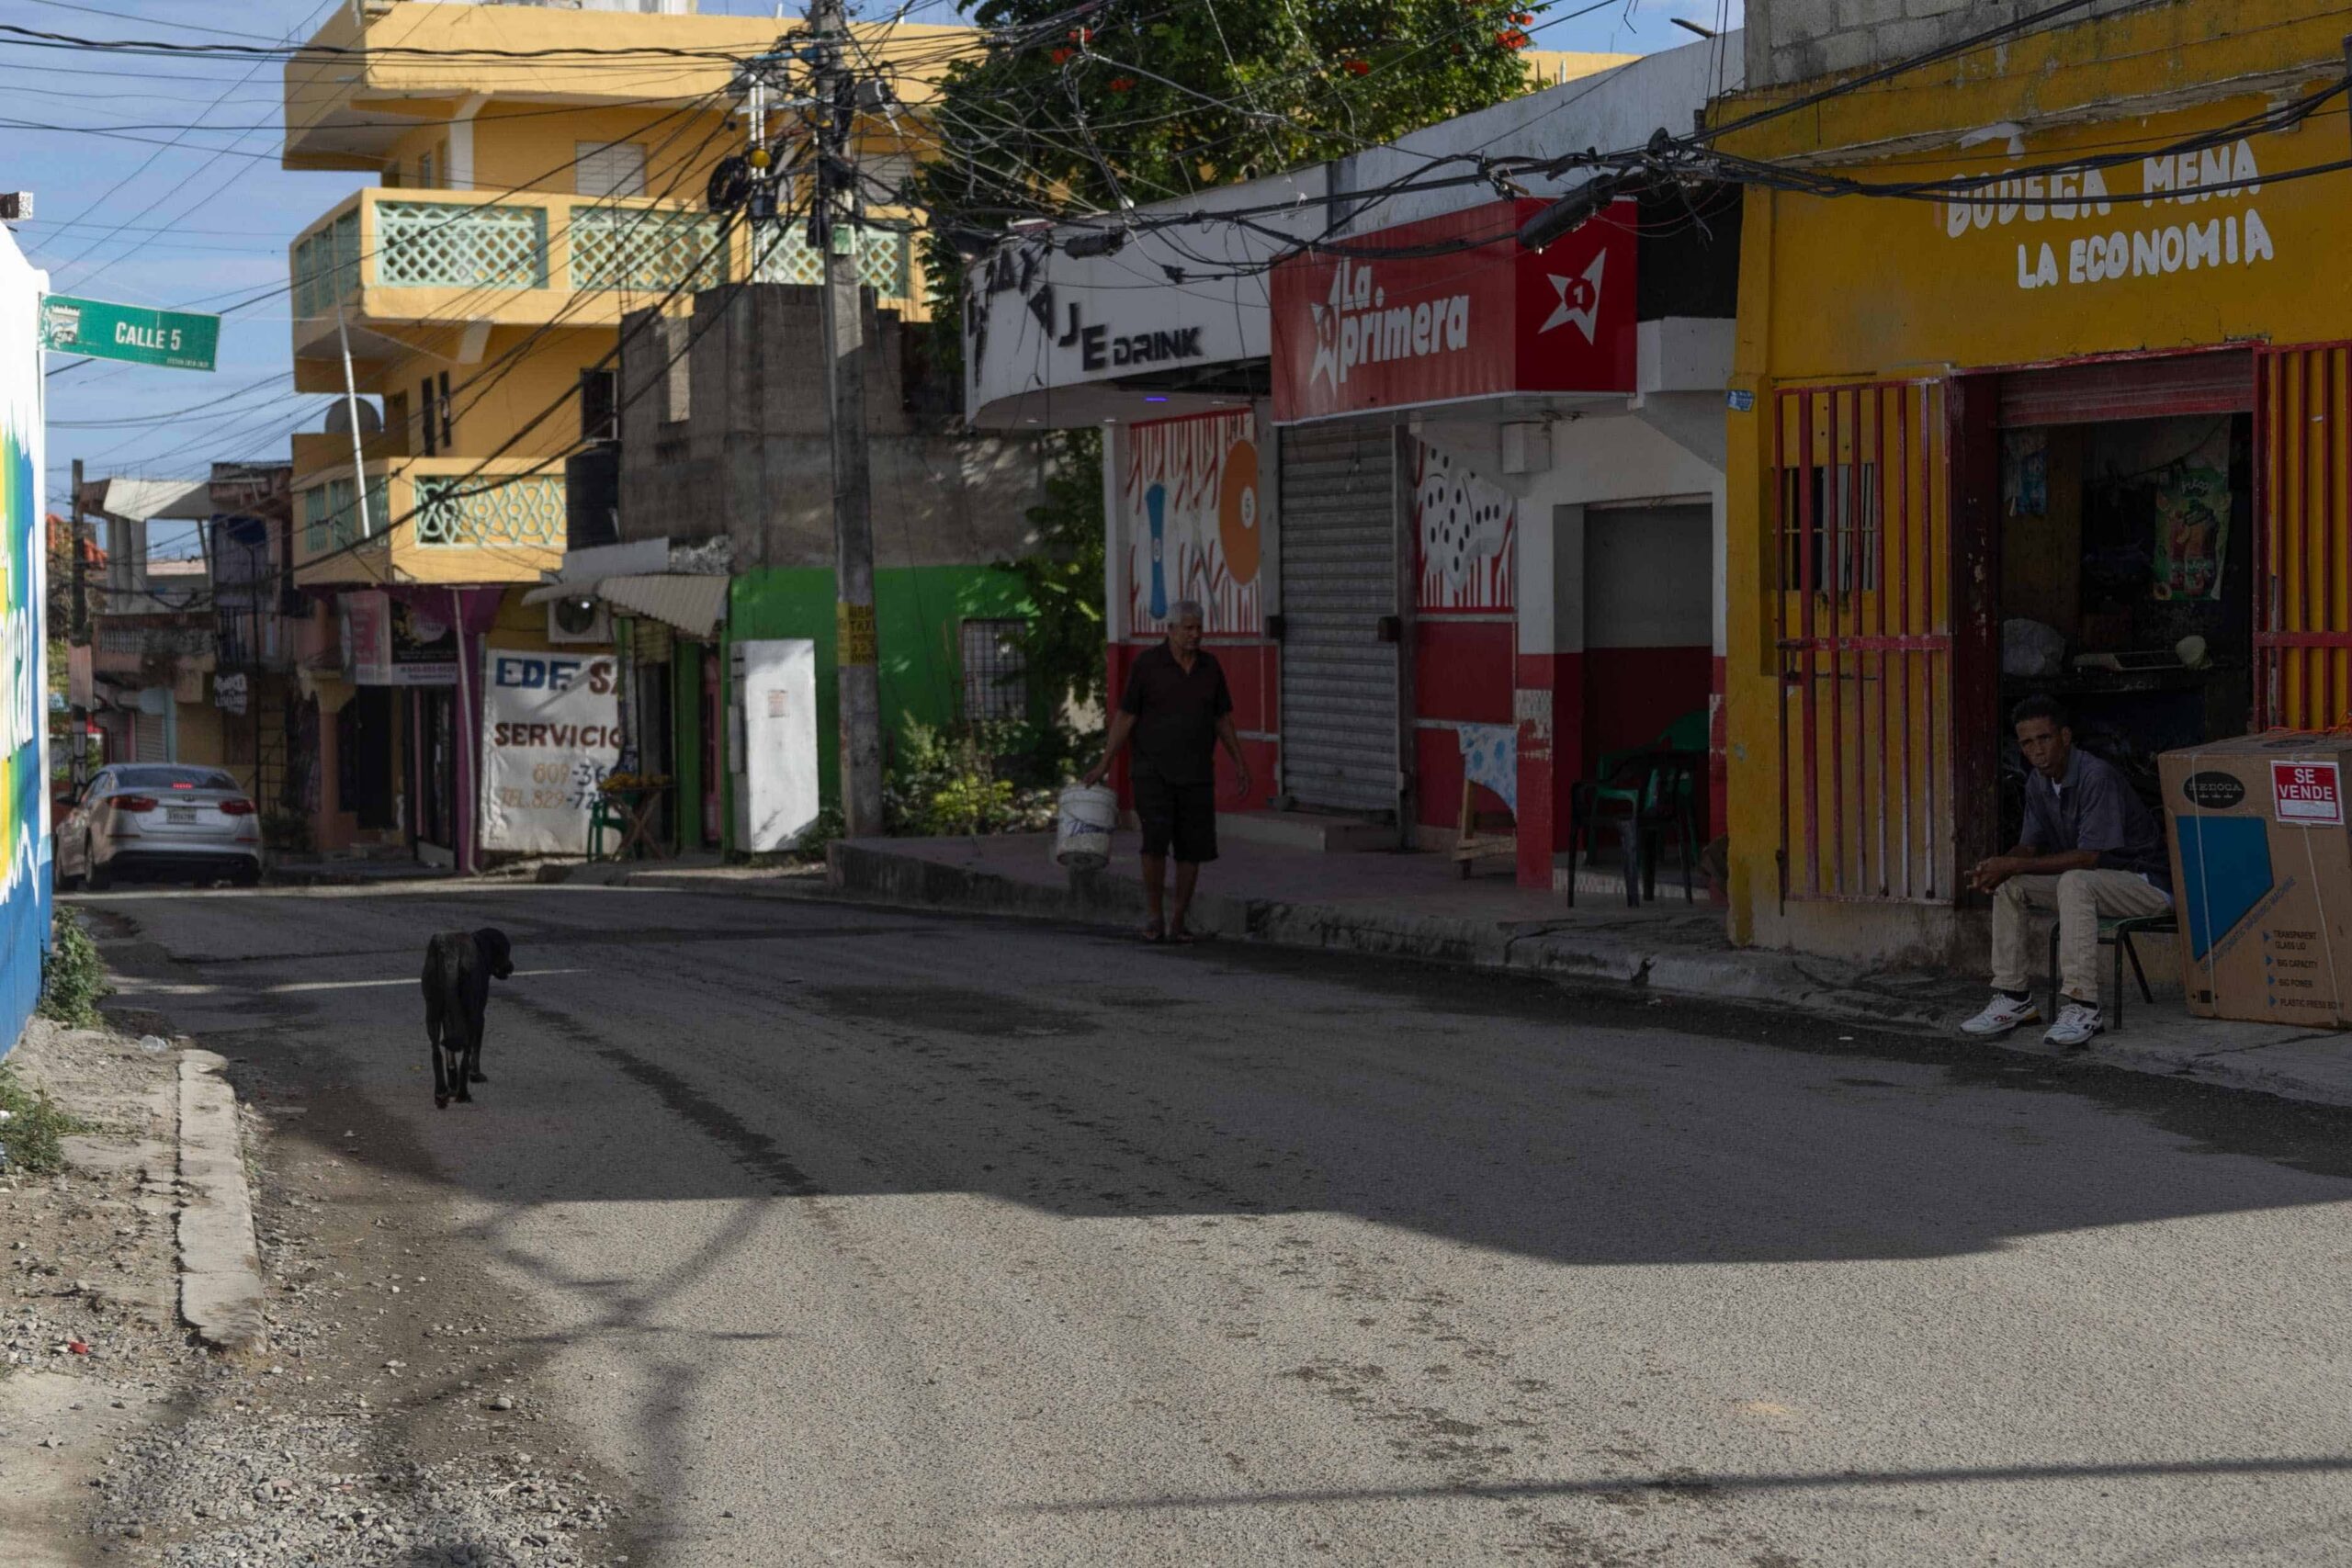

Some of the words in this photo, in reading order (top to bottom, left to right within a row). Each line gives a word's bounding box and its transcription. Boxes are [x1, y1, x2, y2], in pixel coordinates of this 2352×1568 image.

[2143, 139, 2261, 209] MENA
[2018, 242, 2059, 289] LA
[2068, 208, 2274, 284] ECONOMIA
[1341, 255, 1373, 311] La
[1573, 285, 1584, 305] 1
[115, 321, 166, 349] CALLE
[170, 329, 182, 350] 5
[1113, 326, 1204, 367] DRINK
[1339, 292, 1470, 383] primera
[589, 661, 618, 695] S
[2278, 784, 2334, 801] VENDE
[2294, 768, 2315, 784] SE
